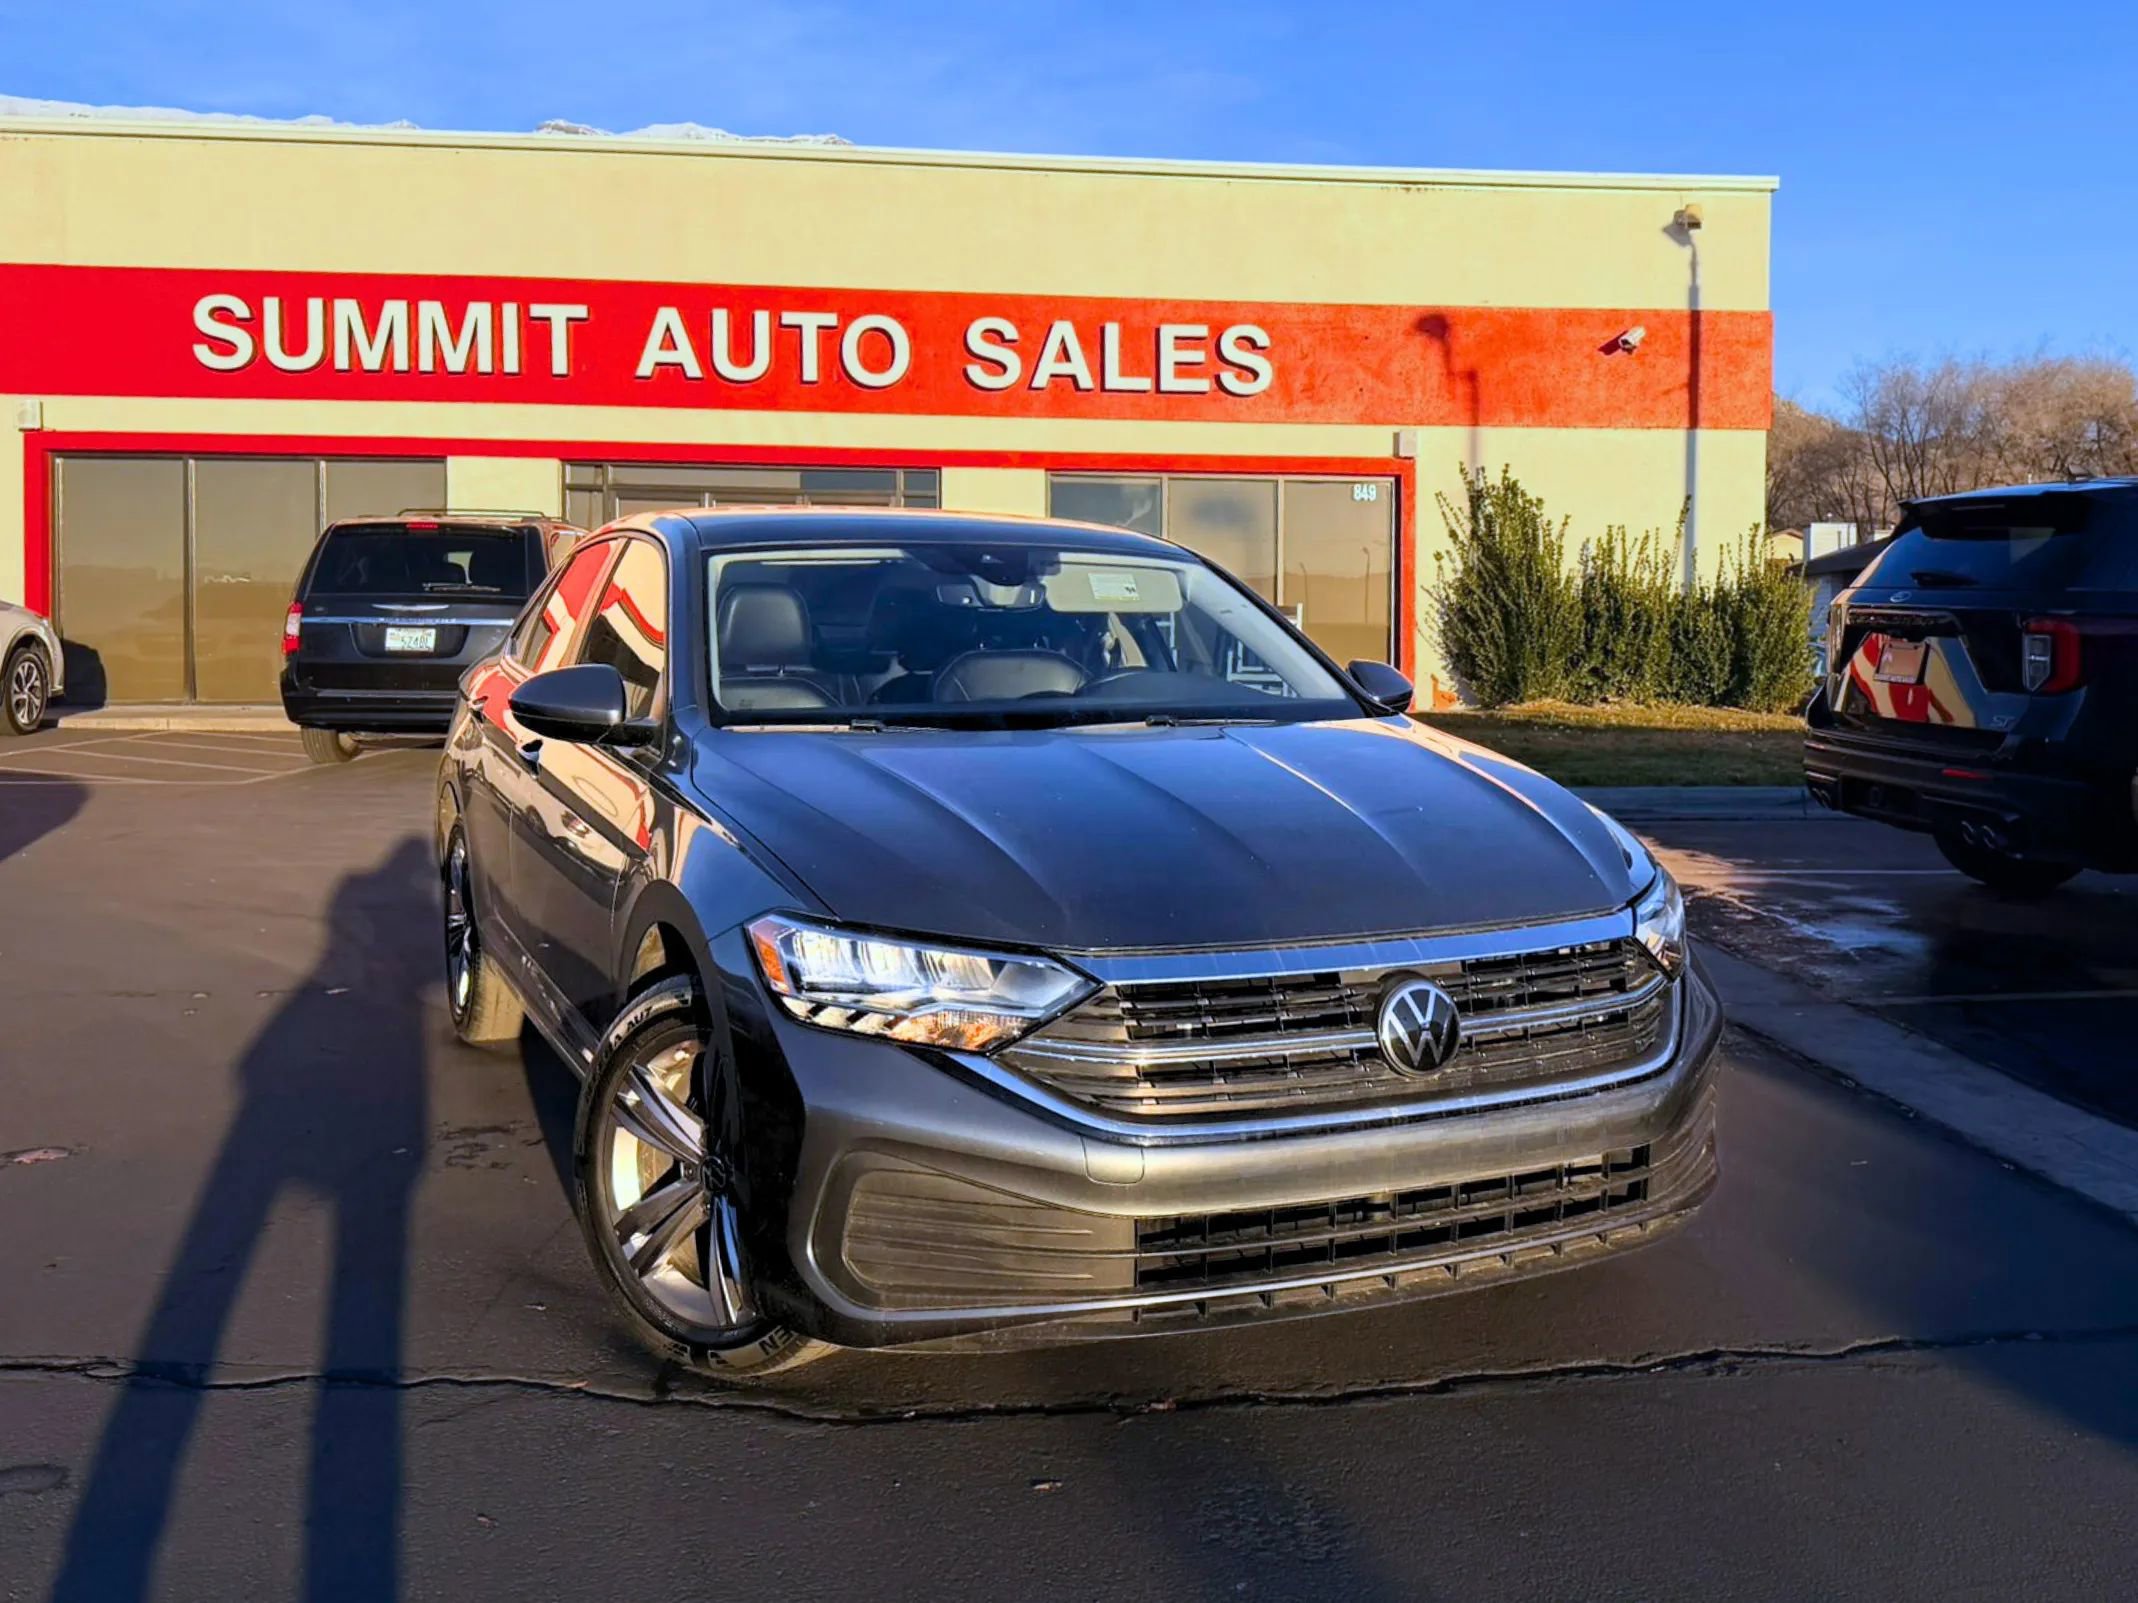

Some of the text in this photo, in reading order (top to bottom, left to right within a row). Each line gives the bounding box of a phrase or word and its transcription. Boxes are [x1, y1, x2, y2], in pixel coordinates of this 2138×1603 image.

[192, 293, 1273, 395] SUMMIT AUTO SALES
[1353, 483, 1377, 502] 849
